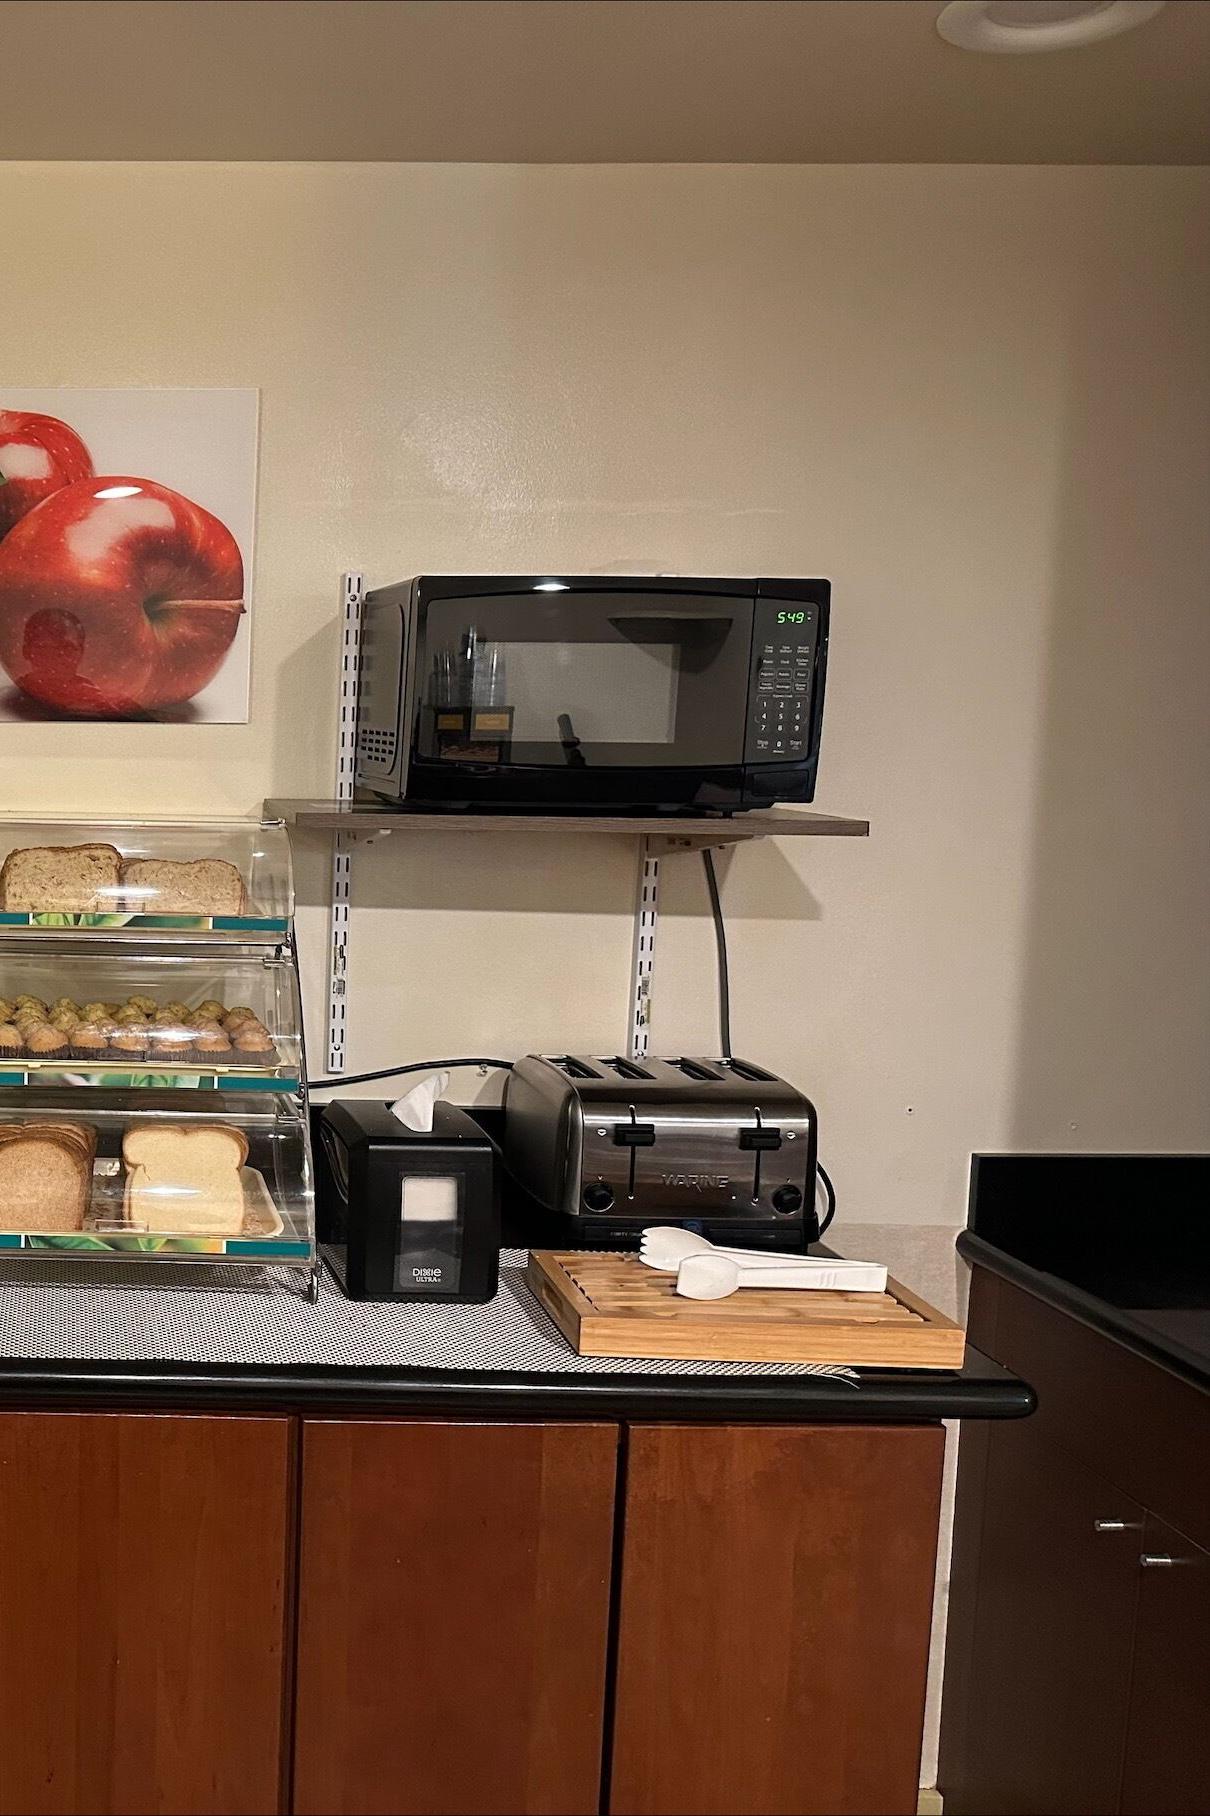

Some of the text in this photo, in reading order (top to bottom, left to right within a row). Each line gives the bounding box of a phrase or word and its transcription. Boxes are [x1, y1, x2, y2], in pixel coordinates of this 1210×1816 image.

[779, 701, 785, 709] 2
[796, 701, 801, 709] 3
[794, 724, 799, 732] 9
